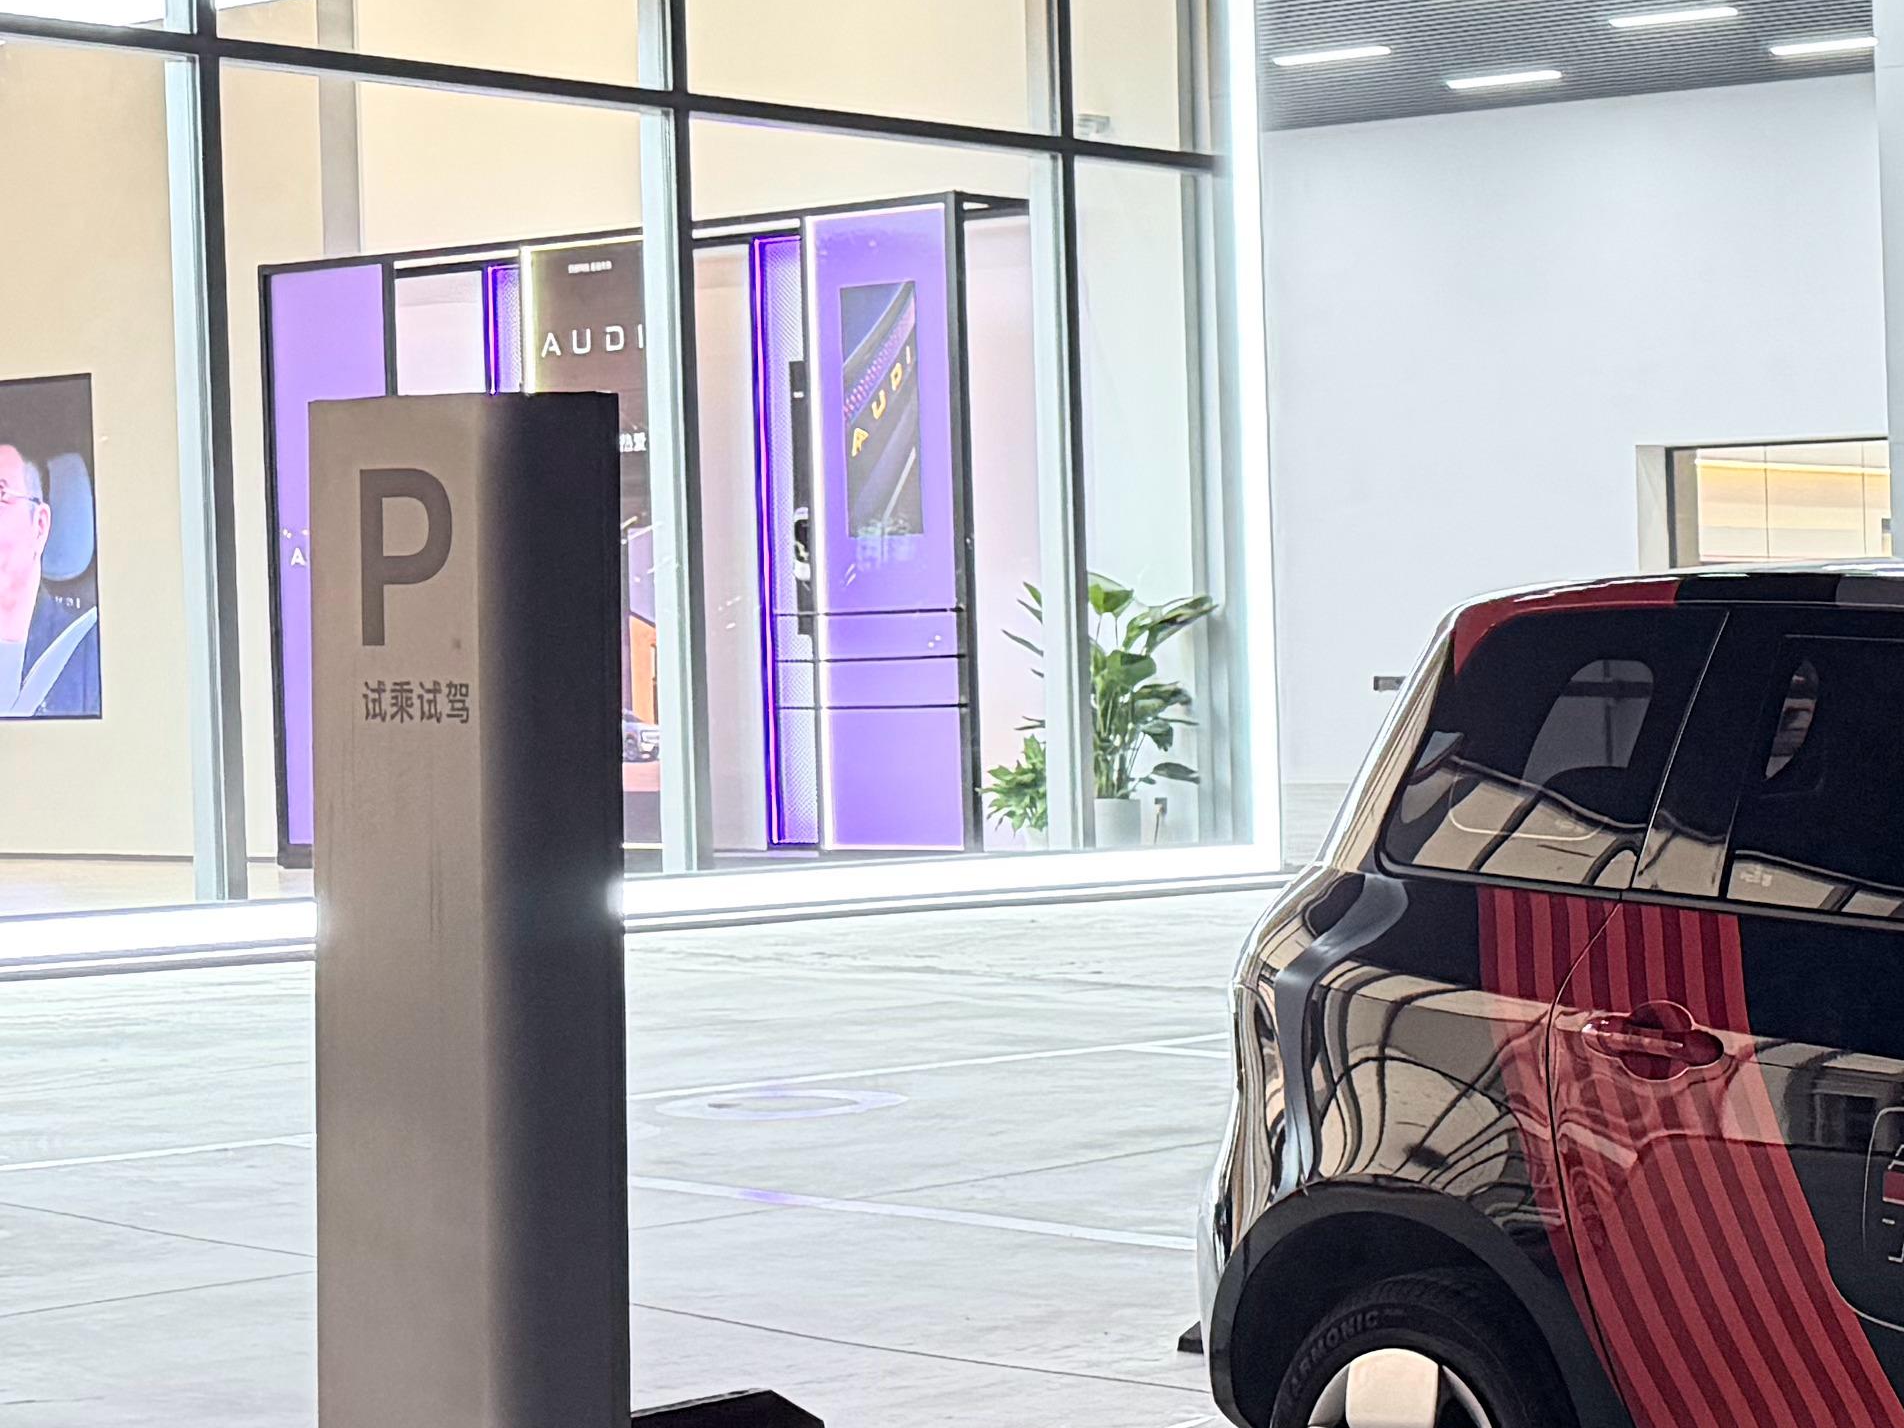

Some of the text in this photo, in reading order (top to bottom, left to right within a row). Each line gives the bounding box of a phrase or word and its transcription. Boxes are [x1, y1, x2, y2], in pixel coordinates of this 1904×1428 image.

[540, 323, 646, 358] AUDI
[358, 467, 454, 647] P
[361, 679, 471, 725] 试乘试驾
